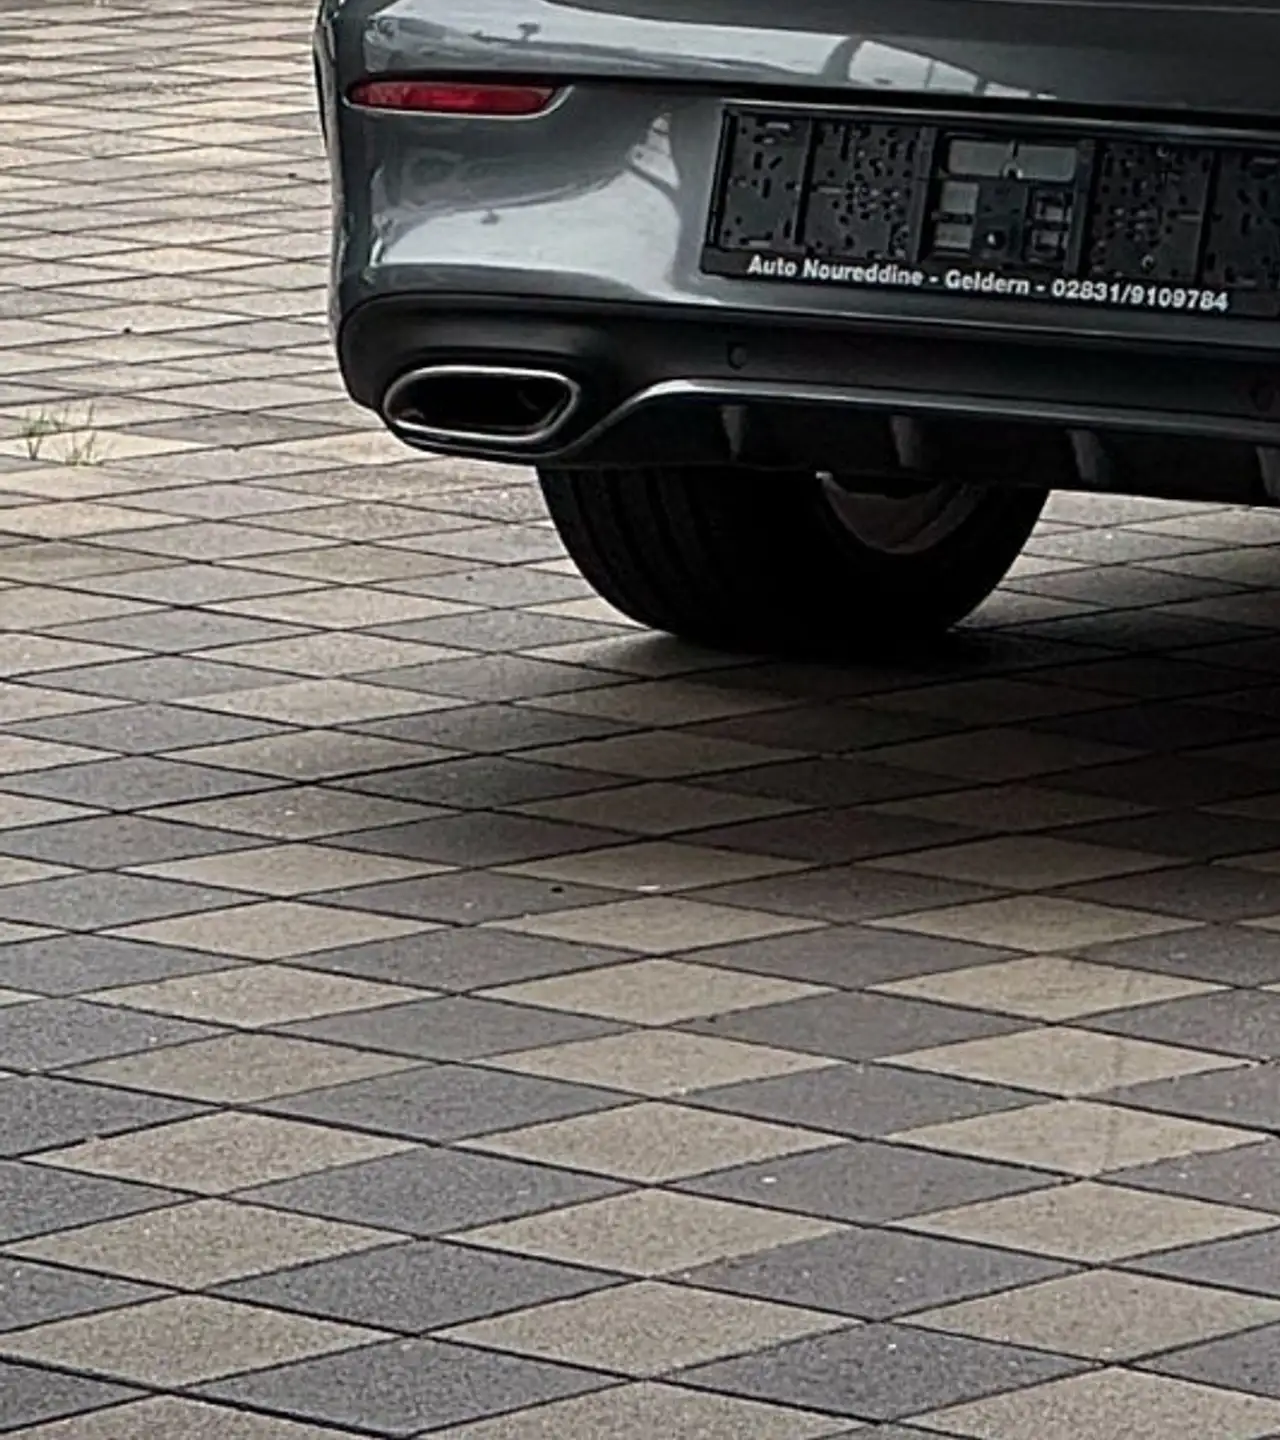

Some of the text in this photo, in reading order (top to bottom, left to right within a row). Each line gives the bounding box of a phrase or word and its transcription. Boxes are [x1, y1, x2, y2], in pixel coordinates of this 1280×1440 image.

[748, 254, 797, 277] Auto
[803, 259, 923, 286] Noureddine
[945, 269, 1030, 296] Geldern
[1052, 278, 1228, 311] 02831/9109784
